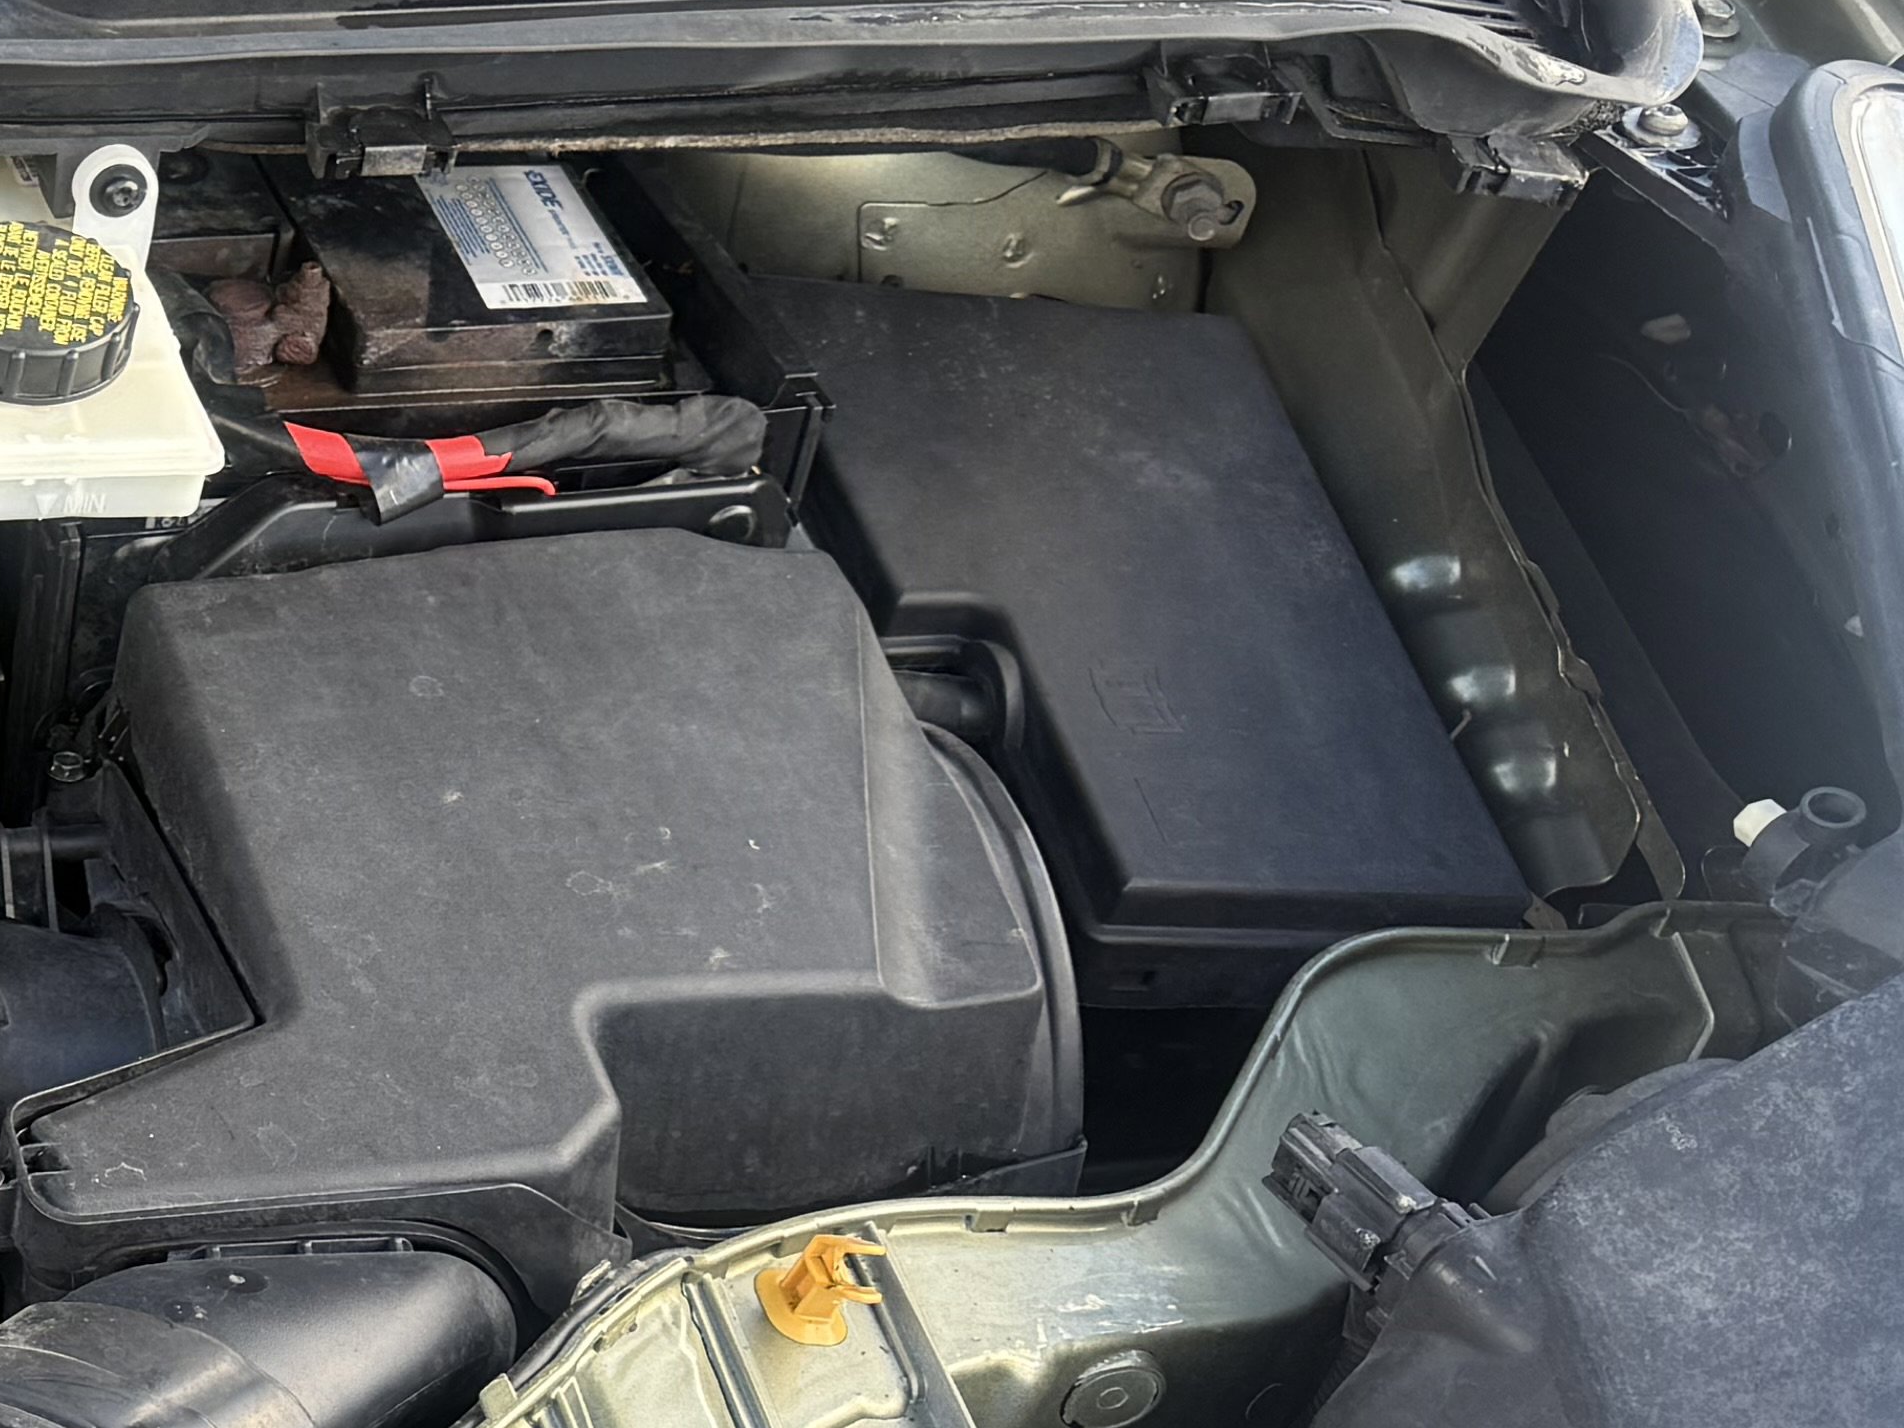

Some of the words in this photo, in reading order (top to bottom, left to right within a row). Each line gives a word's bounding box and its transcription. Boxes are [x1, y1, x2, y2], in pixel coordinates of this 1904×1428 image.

[524, 170, 563, 209] EXIDE
[1, 260, 15, 271] LE
[15, 274, 30, 285] LE
[71, 324, 89, 342] USE
[90, 317, 106, 336] CAP
[64, 492, 107, 515] MIN
